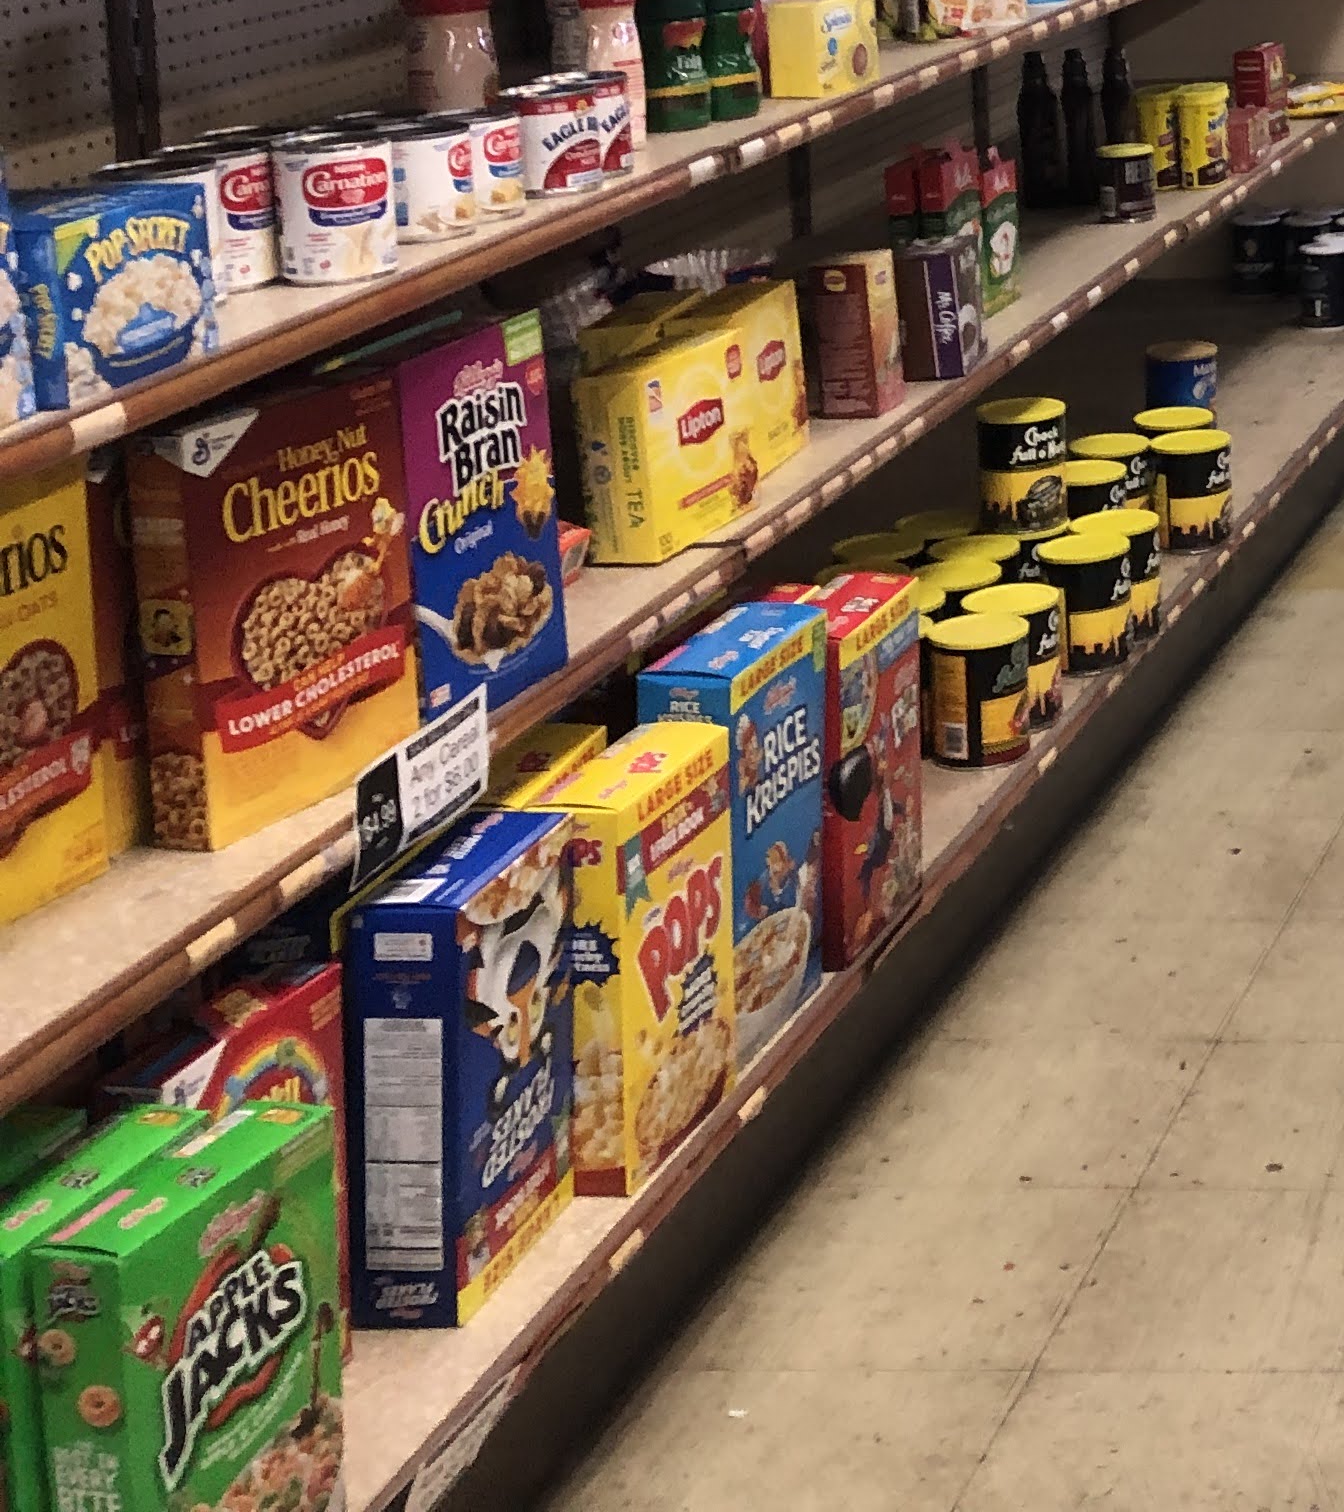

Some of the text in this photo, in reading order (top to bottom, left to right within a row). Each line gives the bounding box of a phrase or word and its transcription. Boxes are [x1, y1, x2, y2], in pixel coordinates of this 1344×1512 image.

[305, 168, 388, 198] Carnation
[440, 385, 524, 450] Raisin
[680, 406, 722, 439] Lipton
[454, 426, 520, 489] Bran
[222, 450, 381, 543] Cheerios
[419, 468, 506, 555] Crunch
[626, 489, 646, 529] TEA
[228, 698, 293, 736] LOWER
[763, 704, 808, 771] RICE
[637, 748, 714, 822] LARGE SIZE
[746, 738, 822, 835] KRISPIES
[185, 1255, 271, 1359] APPLE
[164, 1265, 302, 1477] JACKS
